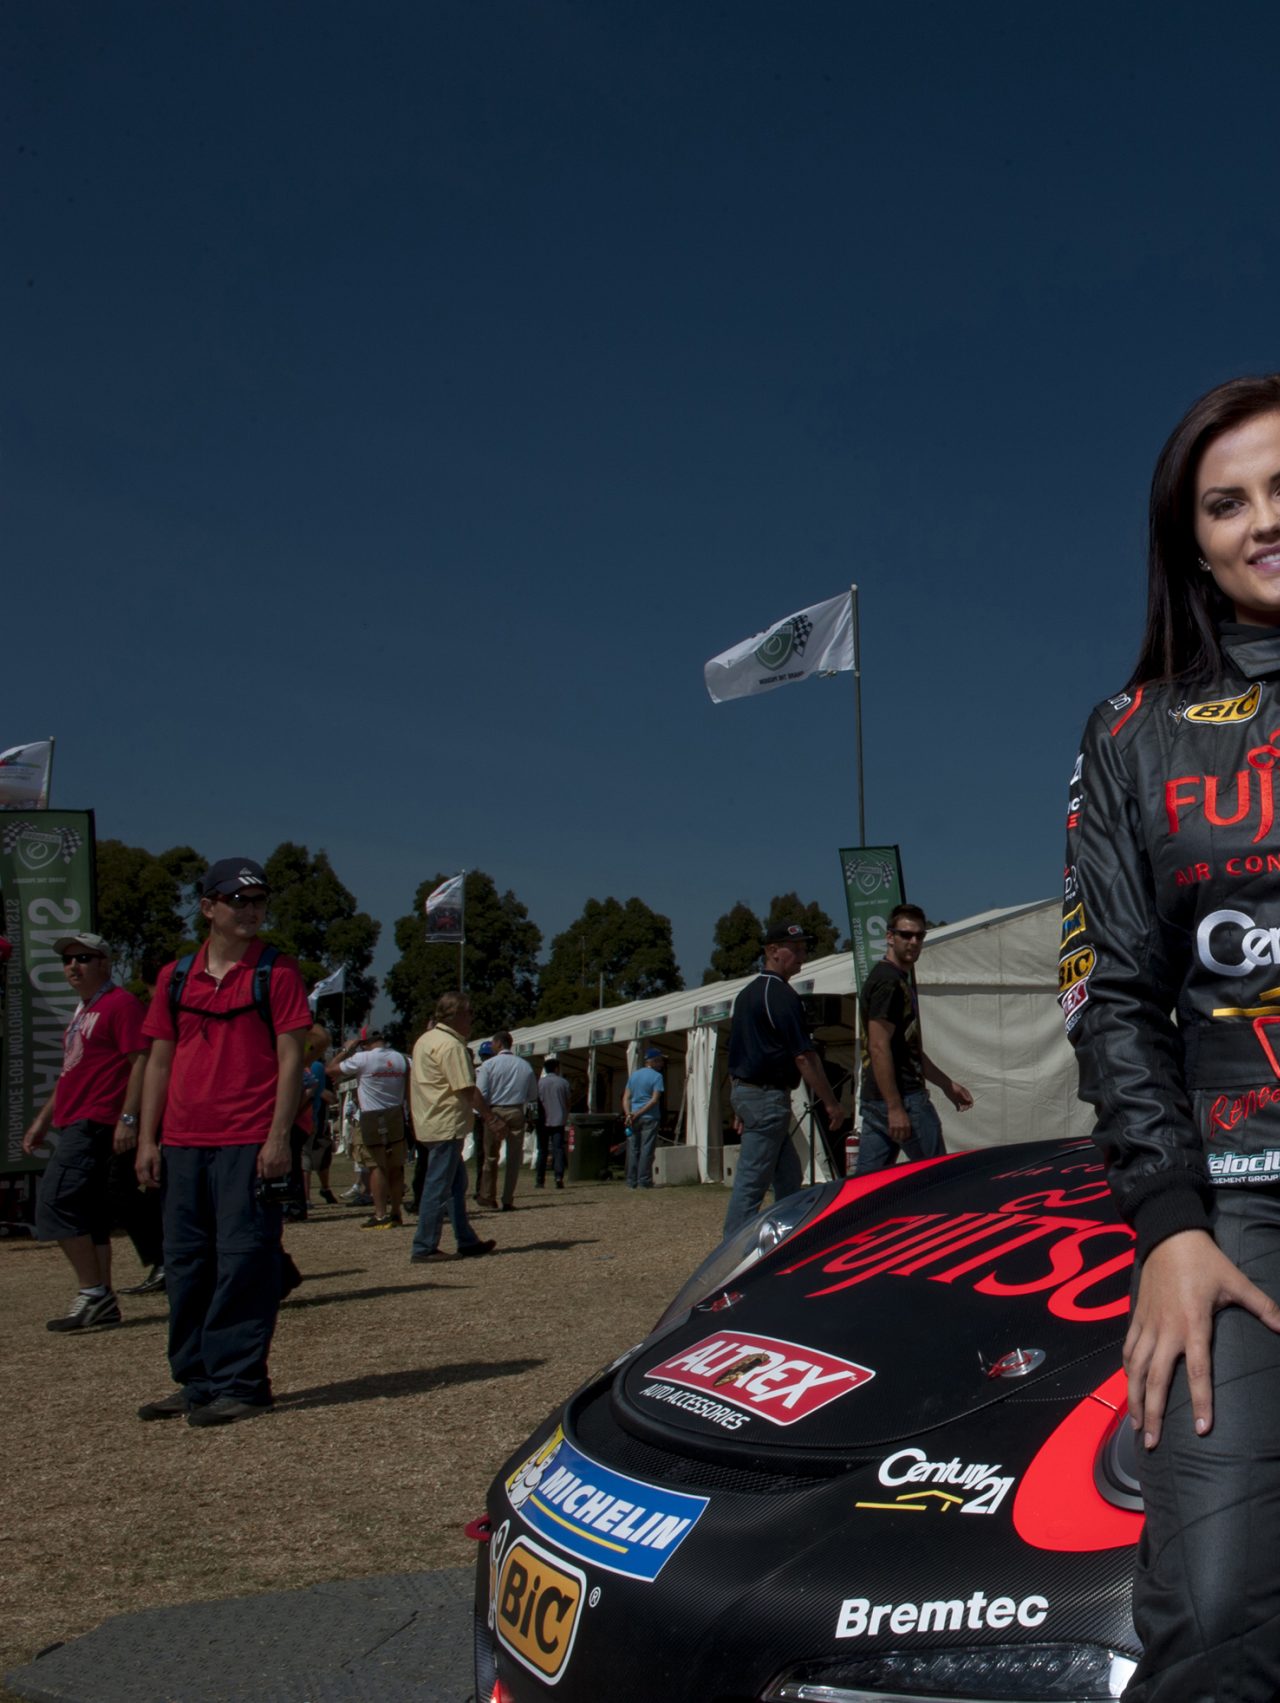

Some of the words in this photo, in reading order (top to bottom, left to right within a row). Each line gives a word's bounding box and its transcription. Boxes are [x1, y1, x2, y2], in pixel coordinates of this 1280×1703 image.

[1174, 863, 1212, 888] AIR
[665, 1340, 858, 1410] ALTREX
[639, 1382, 670, 1401] AUTO
[667, 1388, 751, 1431] ACCESSORIES
[877, 1447, 1003, 1490] Century
[534, 1464, 693, 1551] MICHELIN
[959, 1476, 1015, 1515] 21
[834, 1591, 1050, 1639] Bremtec
